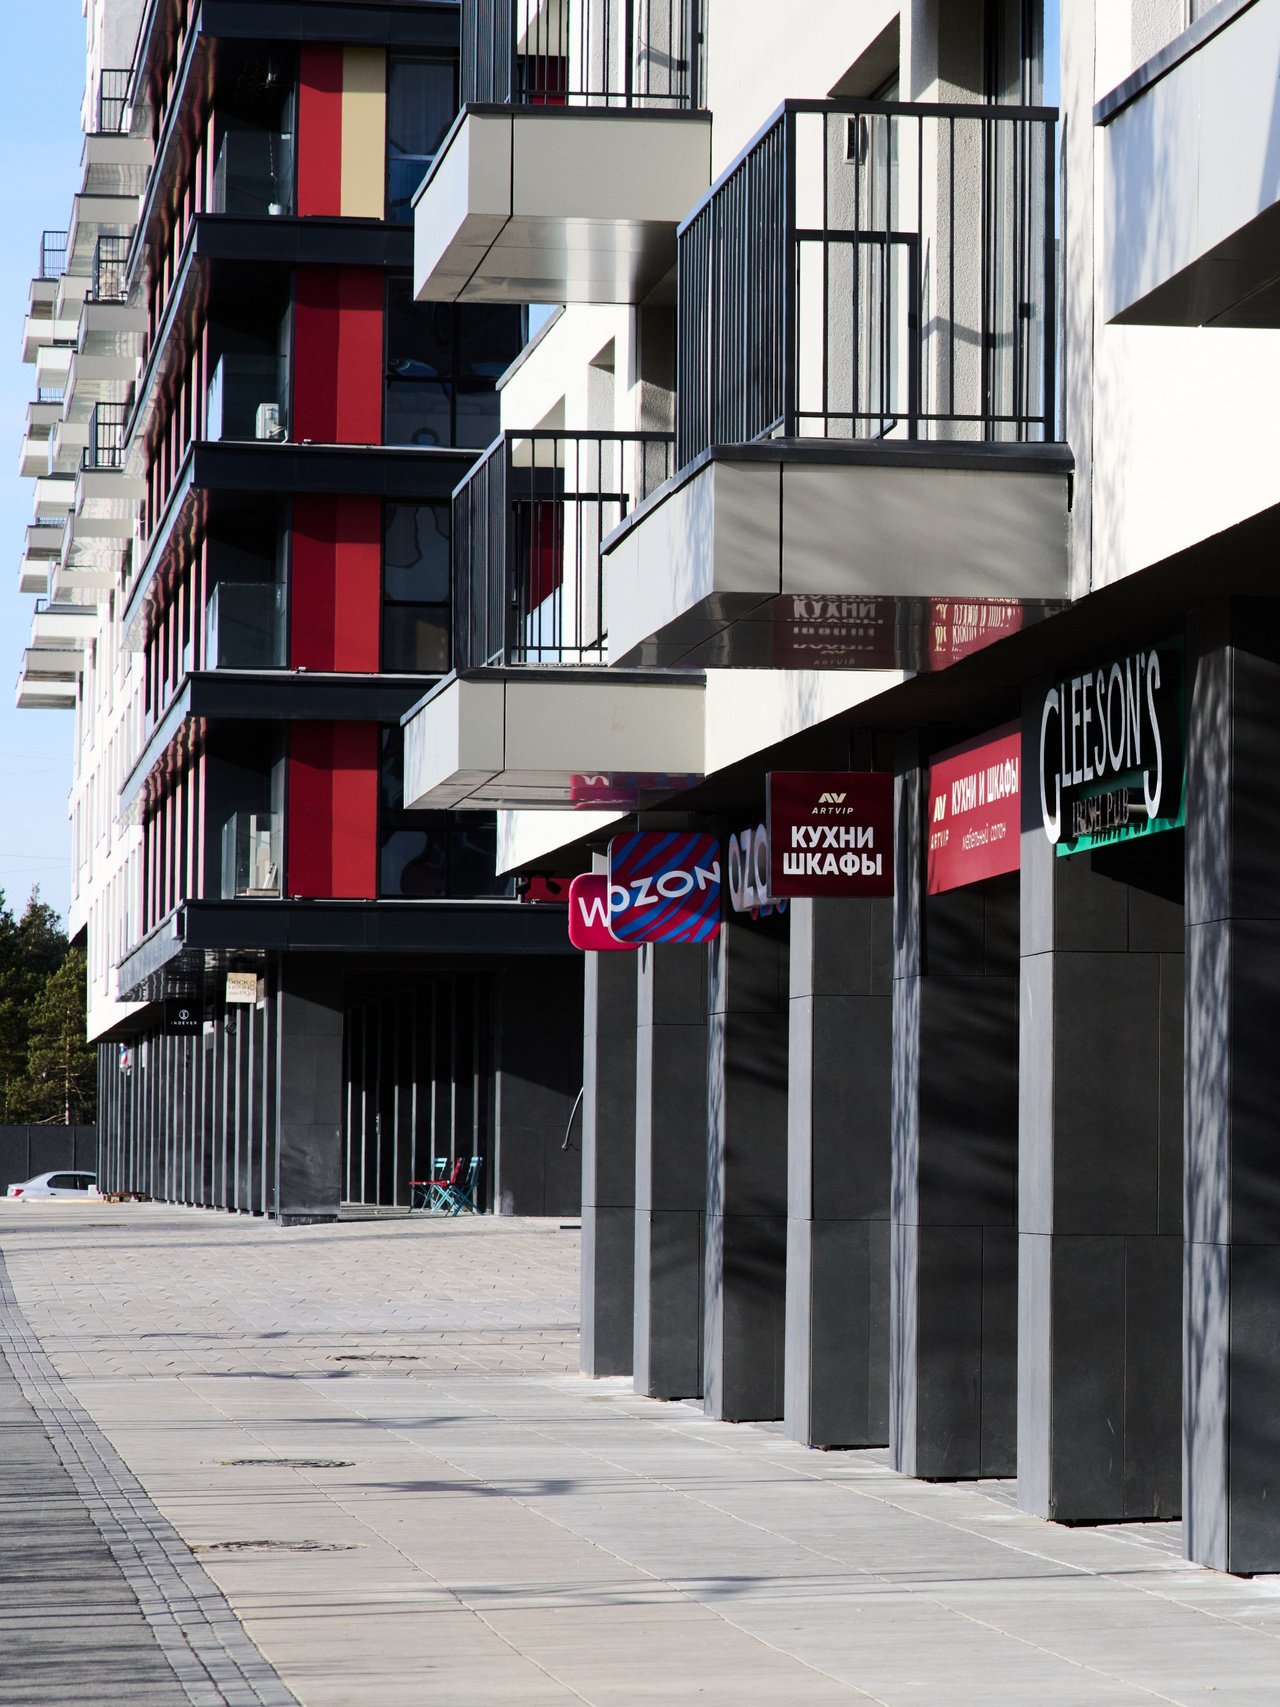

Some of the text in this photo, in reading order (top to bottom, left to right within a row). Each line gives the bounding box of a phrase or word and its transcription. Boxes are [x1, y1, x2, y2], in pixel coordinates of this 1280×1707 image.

[951, 757, 1019, 816] КУХНИ И ШКАФЫ
[1072, 787, 1130, 838] IRISH PUB
[791, 826, 874, 848] КУХНИ
[930, 829, 949, 851] ARTVIP
[783, 852, 882, 876] ШКАФЫ
[611, 861, 720, 912] OZON
